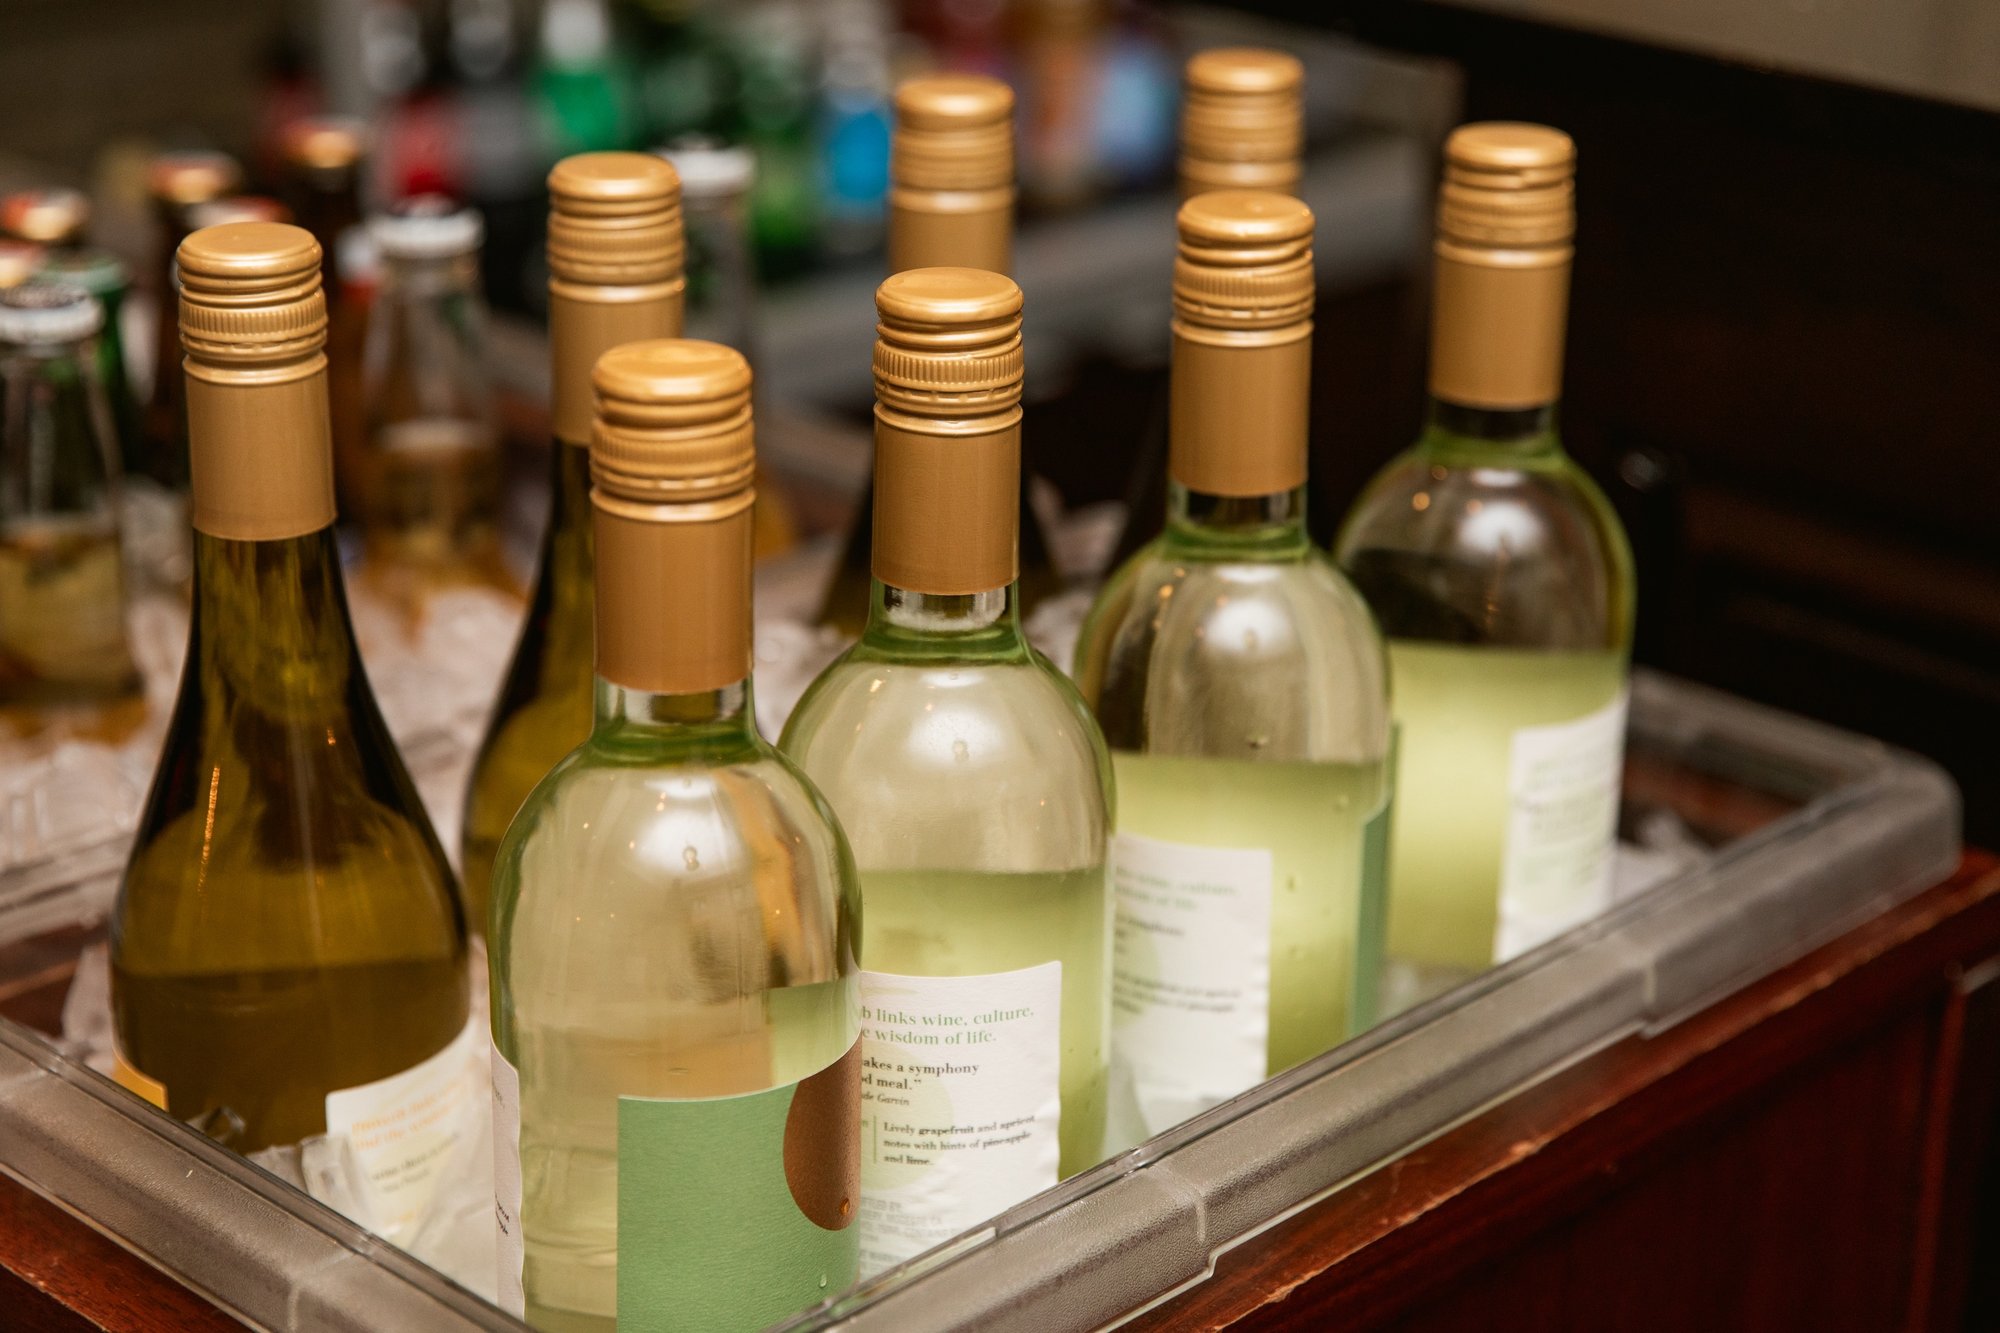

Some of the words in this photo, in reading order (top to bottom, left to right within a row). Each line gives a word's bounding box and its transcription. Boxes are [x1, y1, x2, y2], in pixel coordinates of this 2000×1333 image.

[876, 1008, 916, 1025] links
[875, 1029, 939, 1045] wisdom
[945, 1032, 963, 1045] of
[968, 1030, 997, 1044] life.
[861, 1056, 892, 1070] akes
[896, 1064, 904, 1072] a
[908, 1063, 979, 1077] symphony
[877, 1093, 910, 1106] Garvin
[884, 1121, 915, 1136] Lively
[918, 1126, 974, 1137] grapefruit
[977, 1122, 997, 1133] and
[1000, 1115, 1035, 1130] apricot
[884, 1140, 911, 1149] notes
[914, 1141, 937, 1151] with
[940, 1141, 966, 1151] hints
[969, 1139, 980, 1149] of
[982, 1131, 1032, 1150] pineapple
[884, 1155, 903, 1165] and
